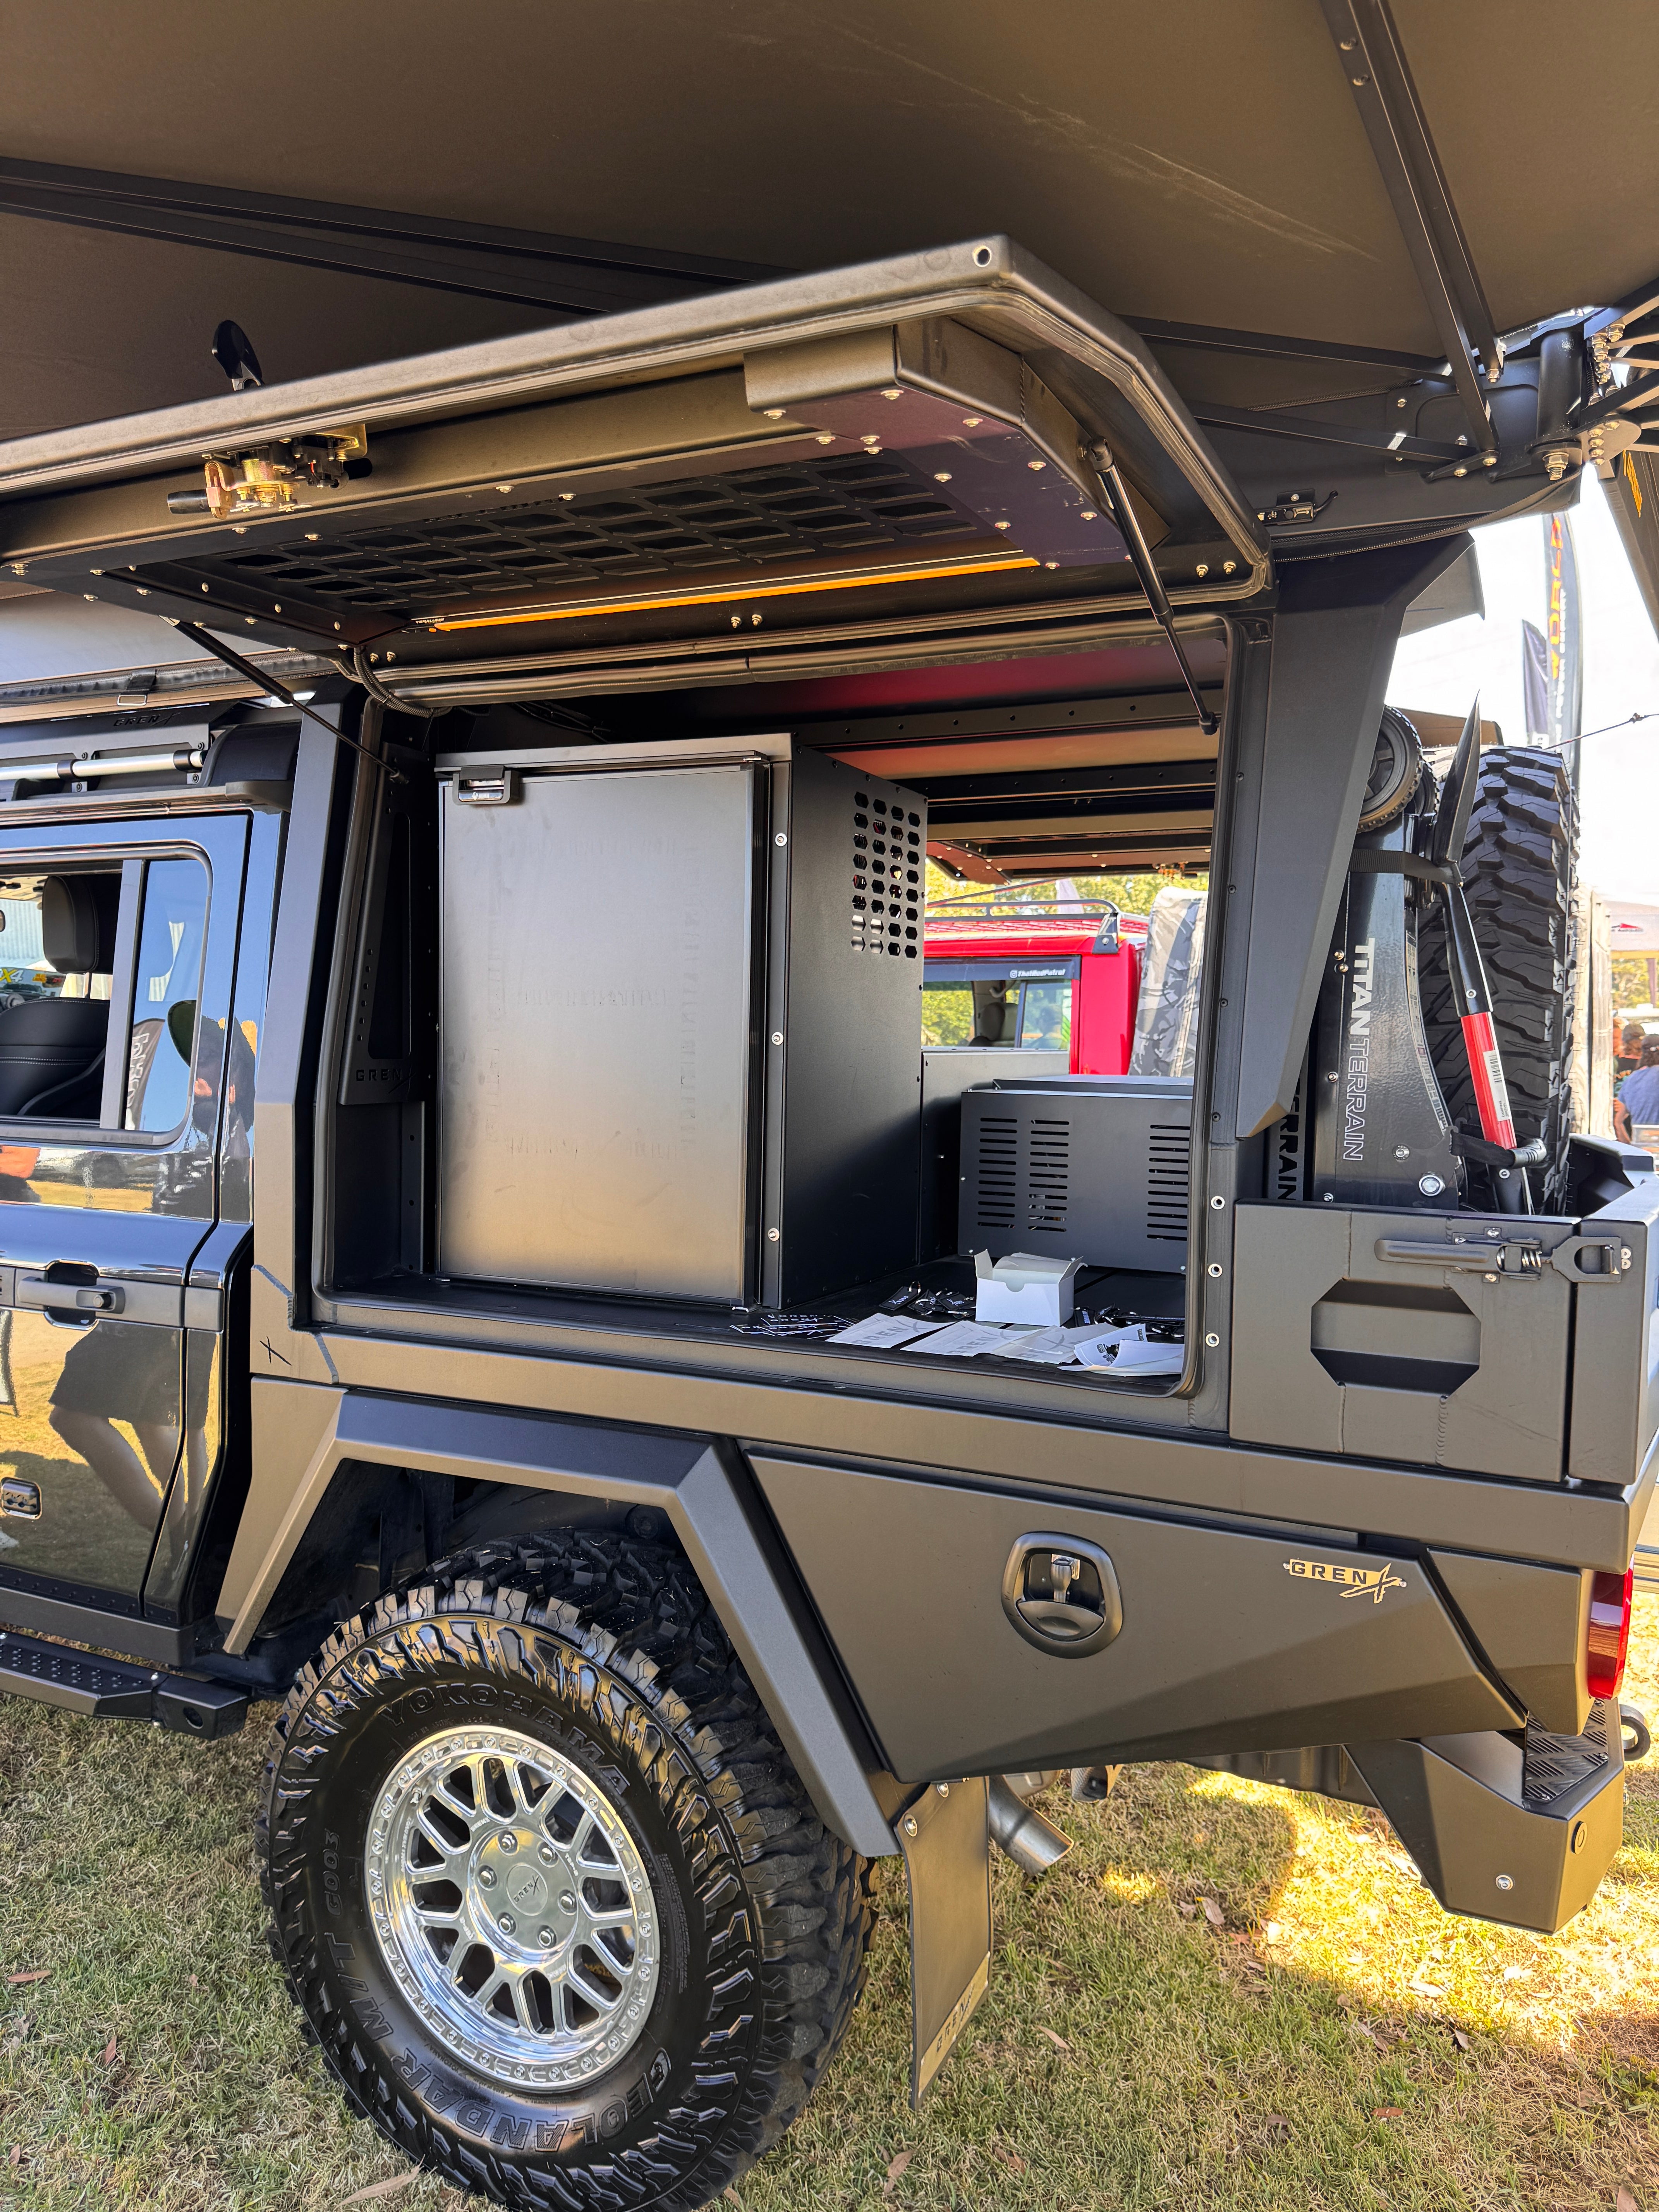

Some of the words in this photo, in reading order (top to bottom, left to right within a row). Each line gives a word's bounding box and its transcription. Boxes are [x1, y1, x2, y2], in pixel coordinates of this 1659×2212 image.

[1549, 515, 1563, 680] WORLD
[0, 969, 24, 983] X4
[1350, 937, 1375, 1036] TITAN
[1343, 1038, 1369, 1161] TERRAIN
[378, 1682, 630, 1795] YOKOHAMA
[323, 1828, 342, 1916] G003
[325, 1932, 394, 2042] M/T
[390, 2047, 672, 2152] GEOLANDAR
